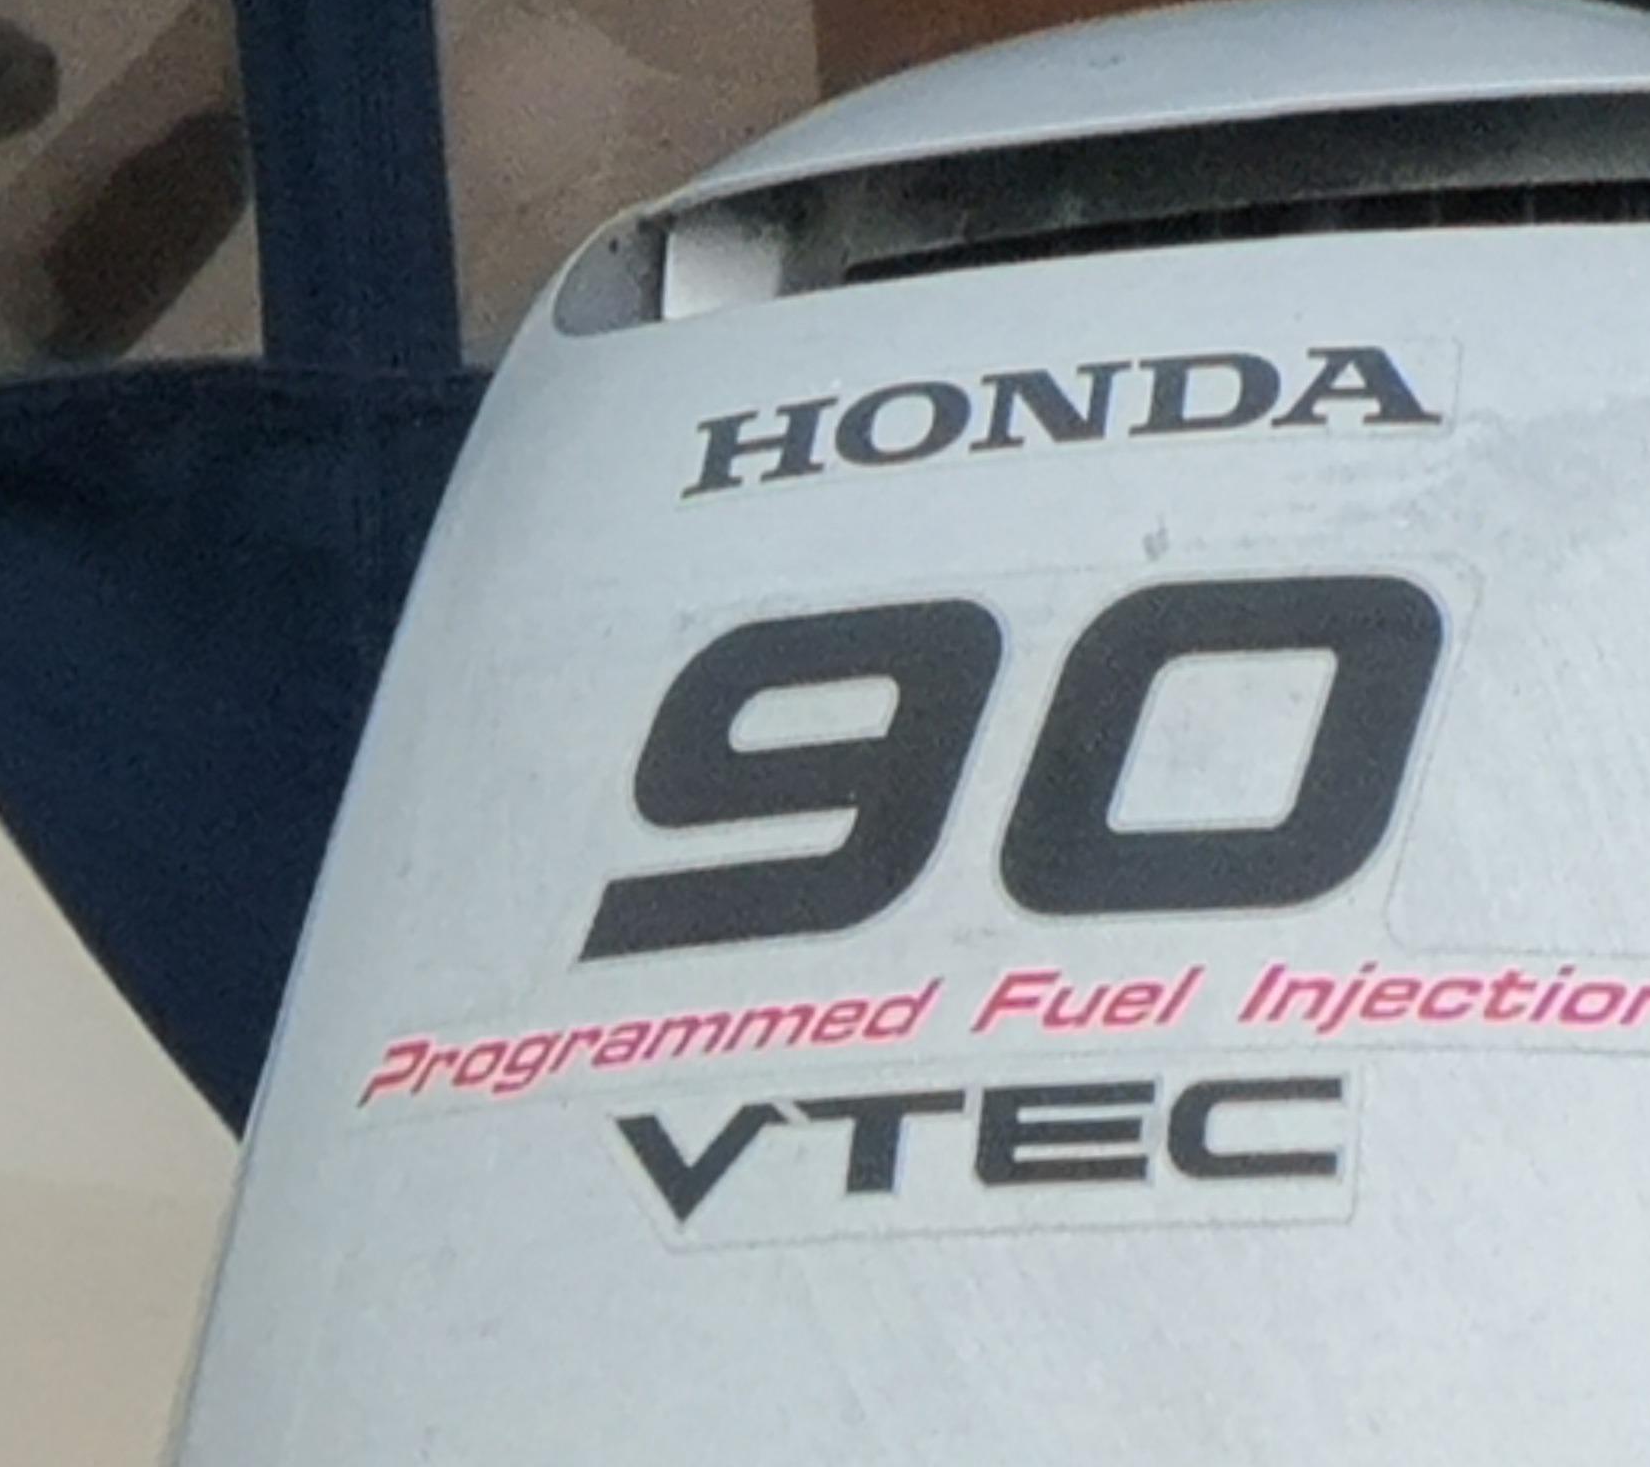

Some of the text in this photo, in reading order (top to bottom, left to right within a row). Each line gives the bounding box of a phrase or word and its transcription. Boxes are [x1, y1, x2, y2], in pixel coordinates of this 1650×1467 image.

[681, 346, 1442, 498] HONDA
[578, 574, 1445, 963] 90
[358, 979, 942, 1106] Programmed
[973, 966, 1207, 1035] Fuel
[614, 1077, 1346, 1227] VTEC
